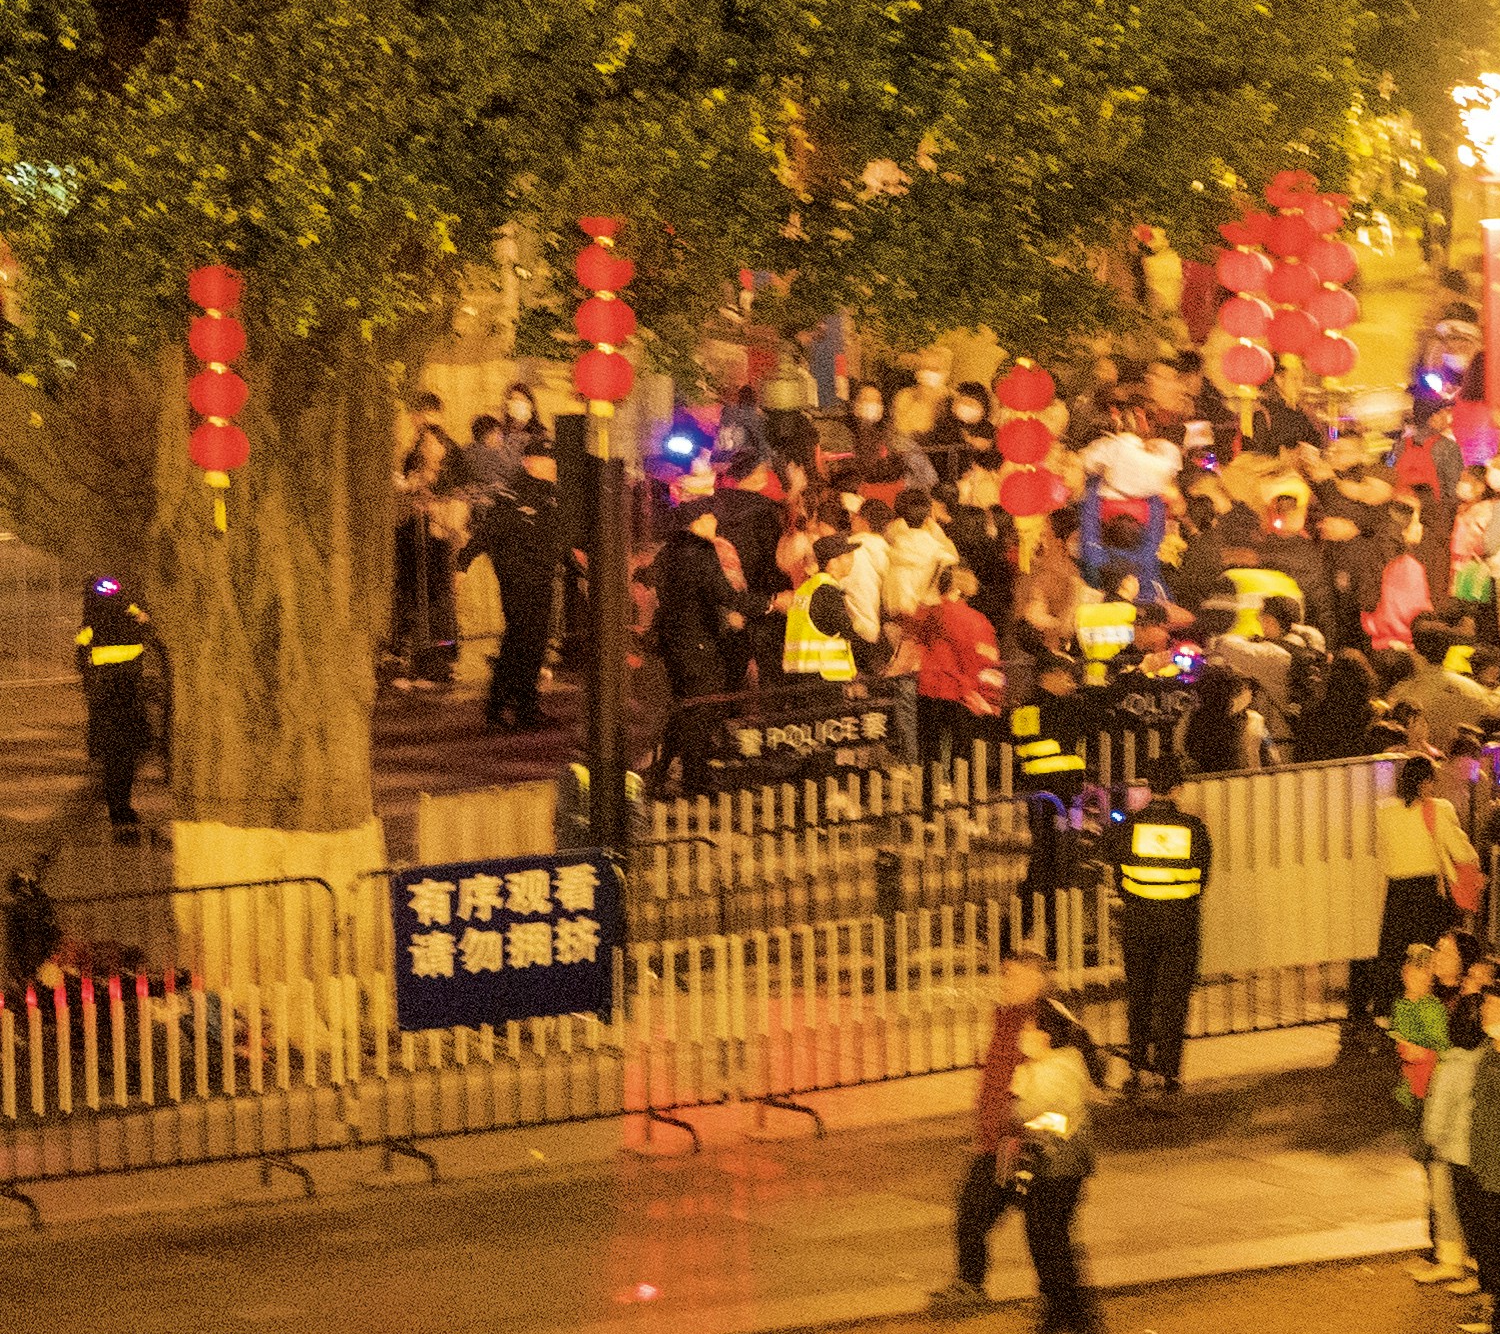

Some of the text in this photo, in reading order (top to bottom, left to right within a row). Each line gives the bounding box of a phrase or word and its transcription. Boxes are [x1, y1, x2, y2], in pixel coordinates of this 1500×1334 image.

[407, 863, 601, 926] 有序观看
[408, 915, 601, 979] 请勿拥挤
